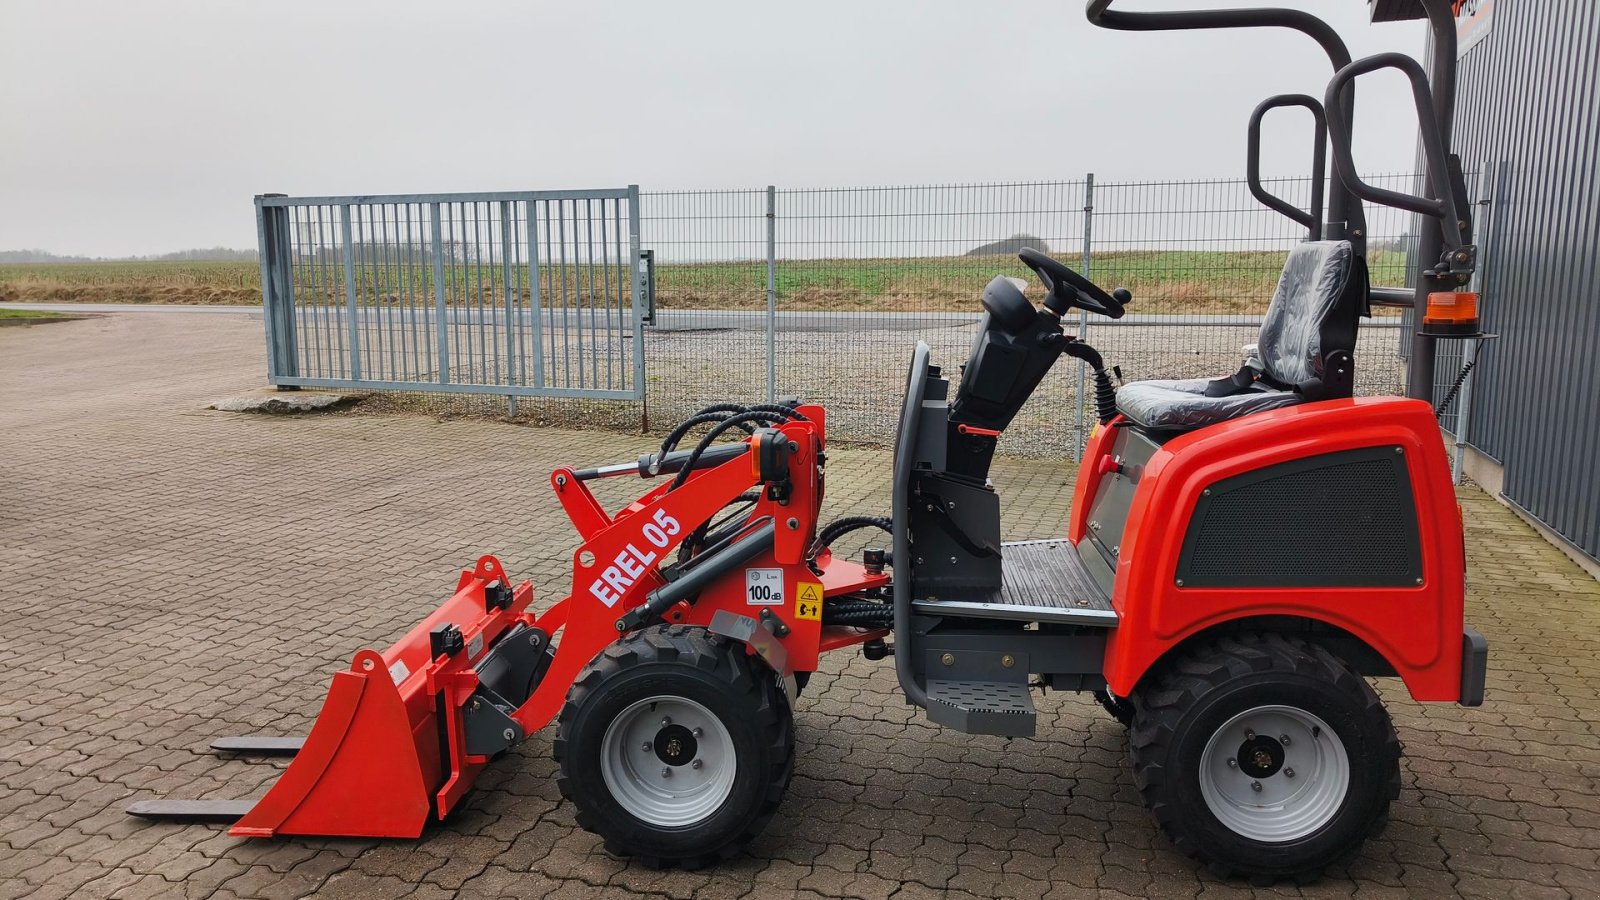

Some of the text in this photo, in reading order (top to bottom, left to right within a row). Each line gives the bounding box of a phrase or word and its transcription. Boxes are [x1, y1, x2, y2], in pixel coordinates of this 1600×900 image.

[588, 543, 657, 608] EREL
[642, 508, 680, 548] 05
[749, 585, 771, 600] 100
